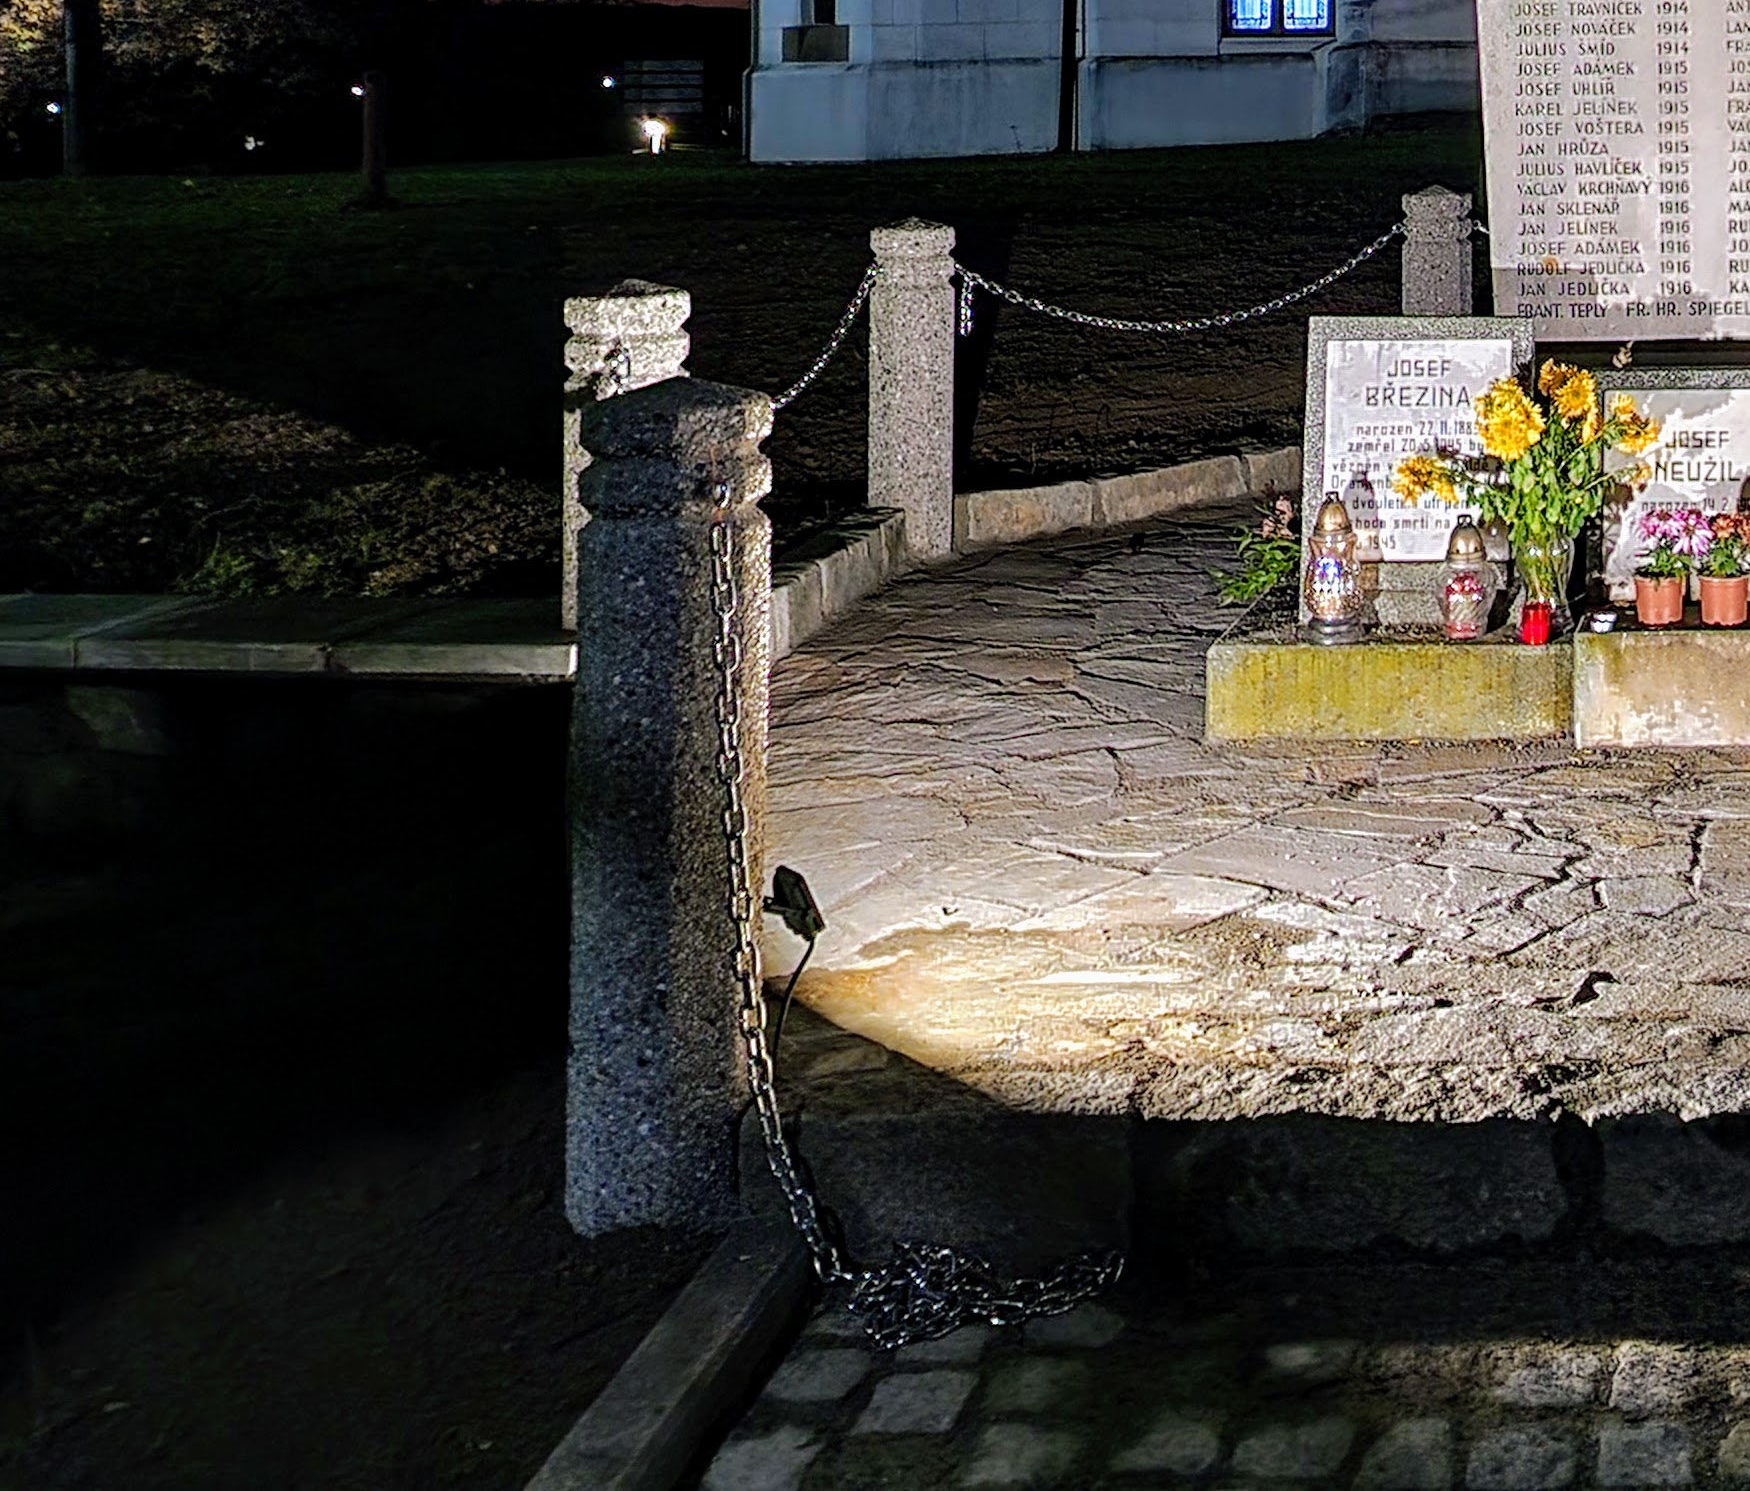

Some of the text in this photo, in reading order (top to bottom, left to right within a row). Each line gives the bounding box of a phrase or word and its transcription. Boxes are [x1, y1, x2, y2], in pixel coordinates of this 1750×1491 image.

[1515, 3, 1558, 17] JOSEF
[1657, 2, 1688, 14] 1914
[1515, 19, 1688, 37] JOSEF NOVÁČEK 1914
[1516, 38, 1689, 56] JULIUS ŠMÍD 1914
[1515, 59, 1688, 76] JOSEF ADÁMEK 1915
[1515, 83, 1562, 96] JOSEF
[1658, 82, 1688, 95] 1915
[1515, 103, 1563, 116] KAREL
[1659, 101, 1689, 114] 1915
[1516, 118, 1689, 136] JOSEF VOŠTERA 1915
[1517, 138, 1689, 156] JAN HRŮZA 1915
[1516, 157, 1689, 176] JULIUS HAVLÍČEK 1915
[1659, 181, 1690, 194] 1916
[1517, 203, 1545, 216] JAN
[1659, 201, 1690, 214] 1916
[1518, 217, 1690, 236] JAN JELÍNEK 1916
[1518, 237, 1691, 255] JOSEF ADÁMEK 1916
[1517, 263, 1571, 276] RUDOLF
[1660, 261, 1691, 274] 1916
[1518, 277, 1692, 296] JAN JEDLIČKA 1916
[1569, 300, 1608, 317] TEPLÝ
[1626, 302, 1650, 316] FR.
[1657, 302, 1681, 316] HR.
[1387, 360, 1451, 377] JOSEF
[1366, 383, 1471, 407] BŘEZINA
[1356, 426, 1412, 436] narozen
[1665, 430, 1730, 449] JOSEF
[1347, 438, 1394, 452] zemřel
[1654, 457, 1741, 482] NEUŽIL
